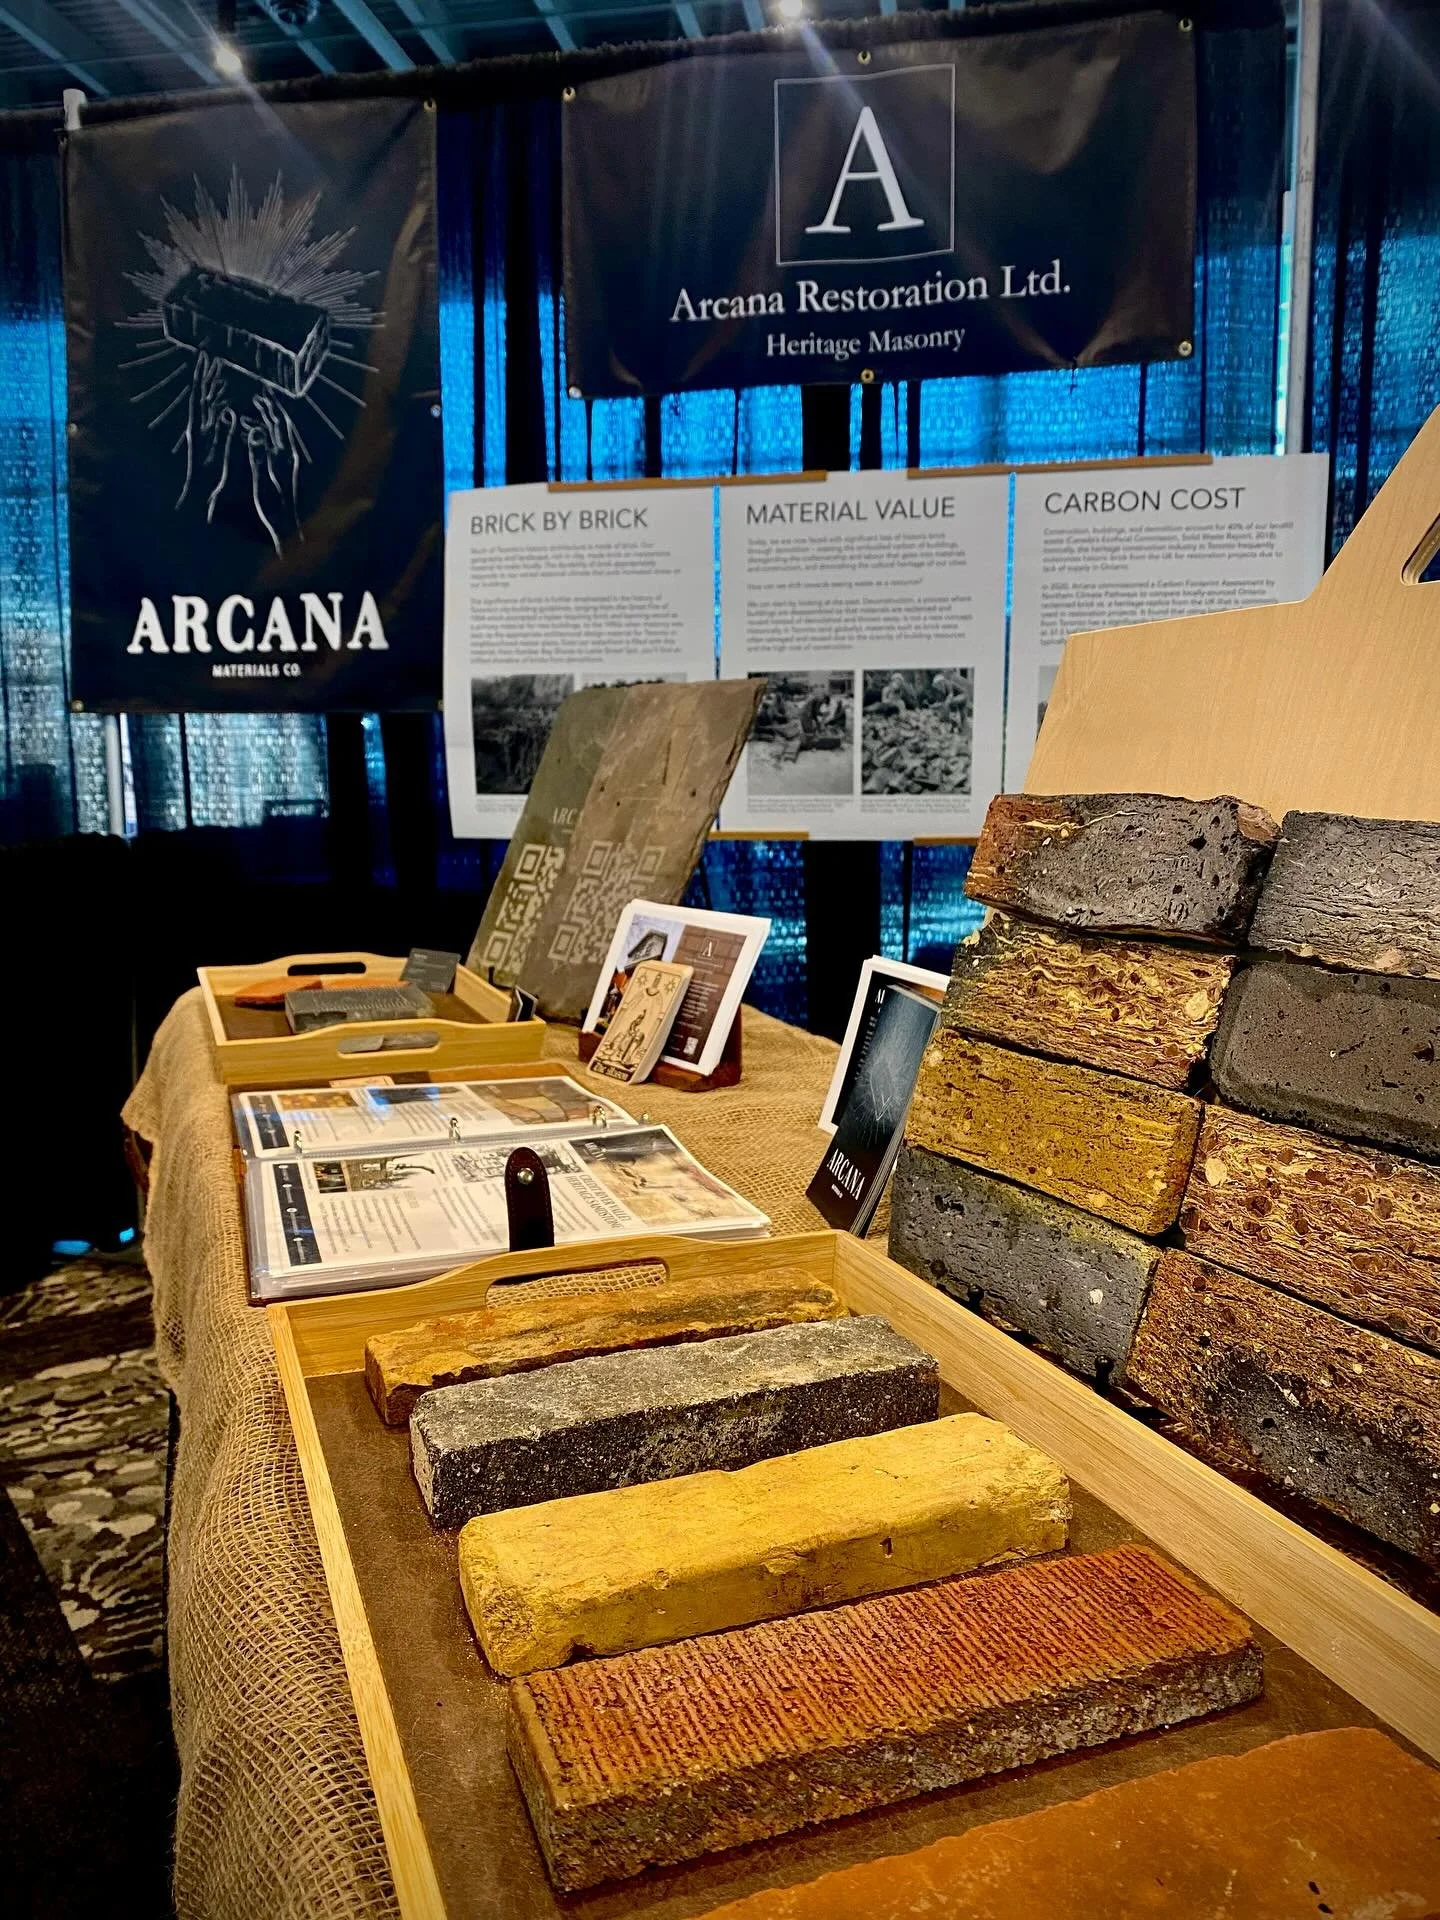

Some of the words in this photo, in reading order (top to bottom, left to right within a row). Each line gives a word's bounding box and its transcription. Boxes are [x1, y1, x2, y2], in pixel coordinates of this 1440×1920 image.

[806, 107, 923, 232] A
[671, 289, 784, 320] Arcana
[798, 271, 988, 312] Restoration
[1002, 259, 1070, 297] Ltd.
[768, 333, 860, 360] Heritage
[869, 330, 964, 352] Masonry
[747, 502, 867, 524] MATERIAL
[876, 497, 954, 519] VALUE
[1045, 491, 1160, 513] CARBON
[1171, 488, 1245, 510] COST
[472, 514, 534, 534] BRICK
[544, 512, 570, 530] BY
[580, 509, 647, 529] BRICK
[127, 592, 388, 653] ARCANA
[212, 664, 279, 677] MATERIALS
[826, 1148, 865, 1200] ARCANA
